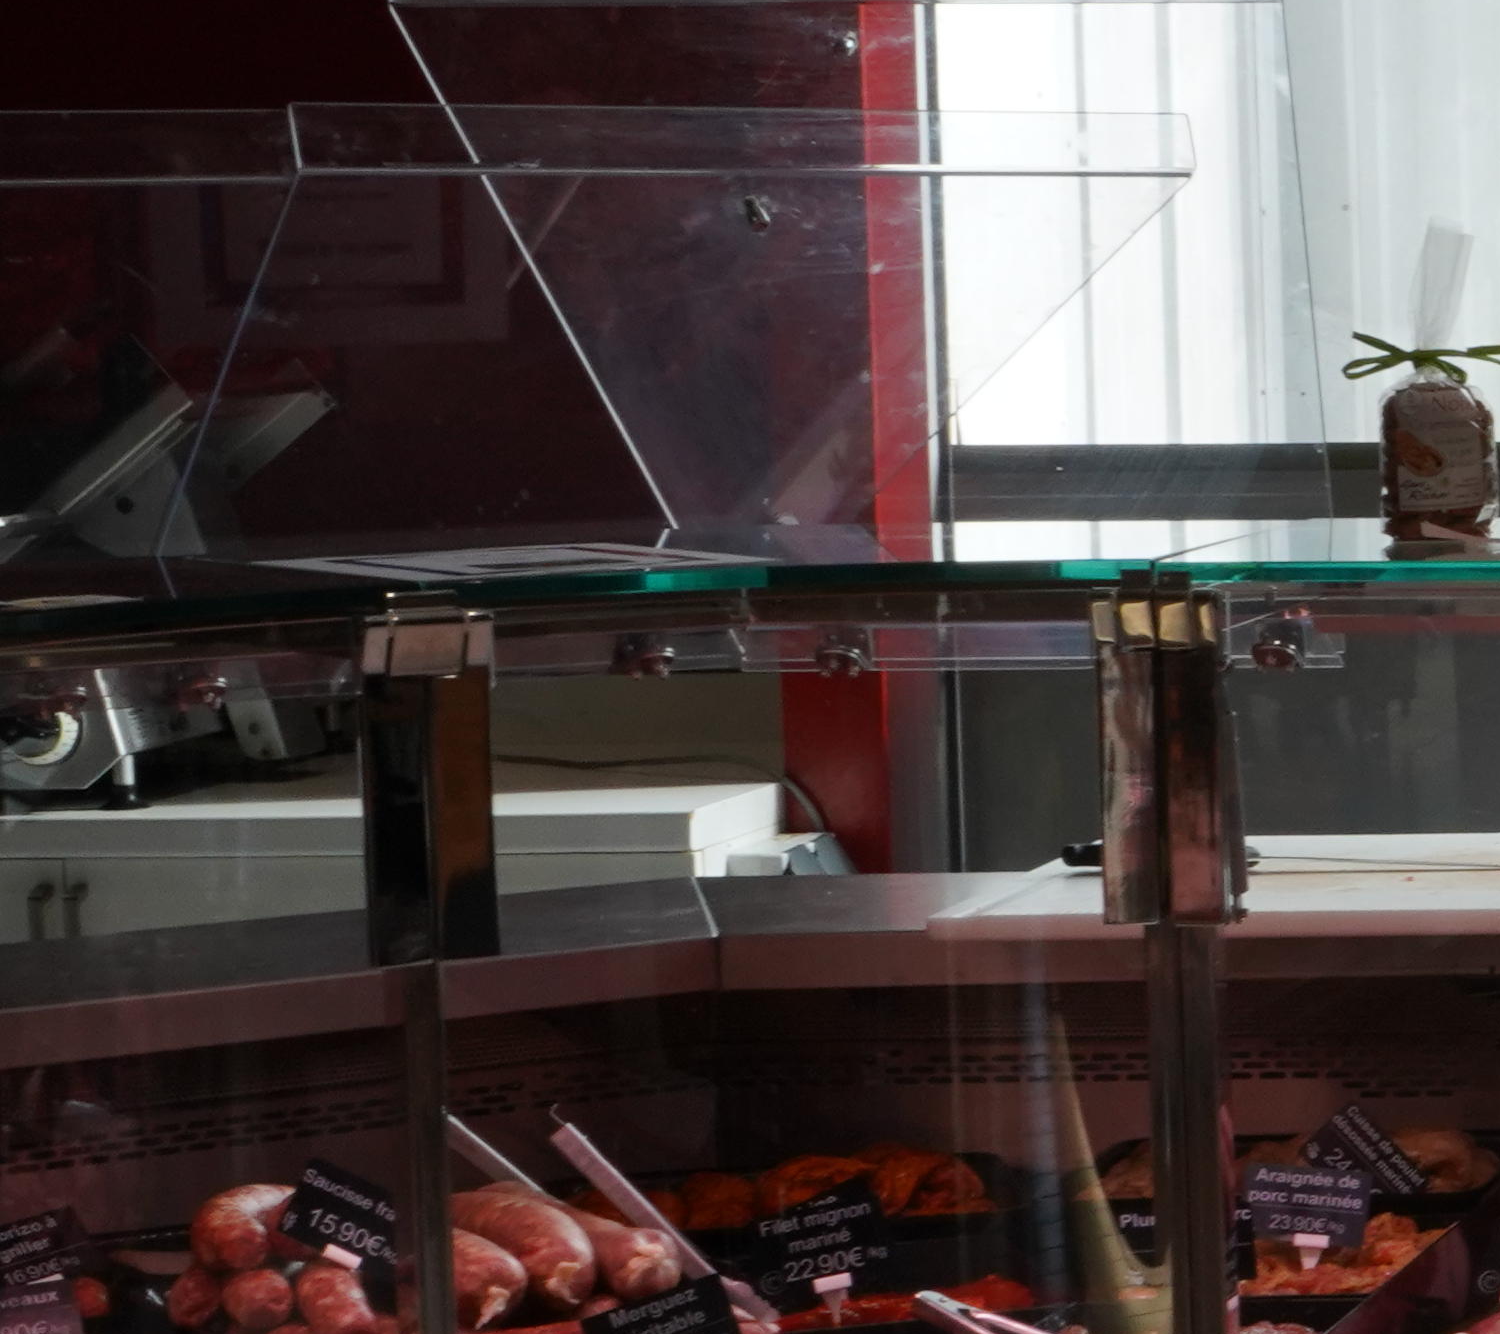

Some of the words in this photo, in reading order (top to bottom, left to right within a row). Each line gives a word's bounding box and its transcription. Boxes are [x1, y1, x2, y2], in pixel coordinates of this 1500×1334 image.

[302, 1168, 375, 1210] Saucisse
[1253, 1167, 1334, 1190] Araignée
[1336, 1171, 1362, 1191] de
[1246, 1187, 1289, 1205] porc
[1291, 1188, 1364, 1210] marinée
[758, 1215, 801, 1238] Filet
[802, 1202, 873, 1227] mignon
[787, 1225, 853, 1255] mariné
[608, 1287, 699, 1329] Merguez
